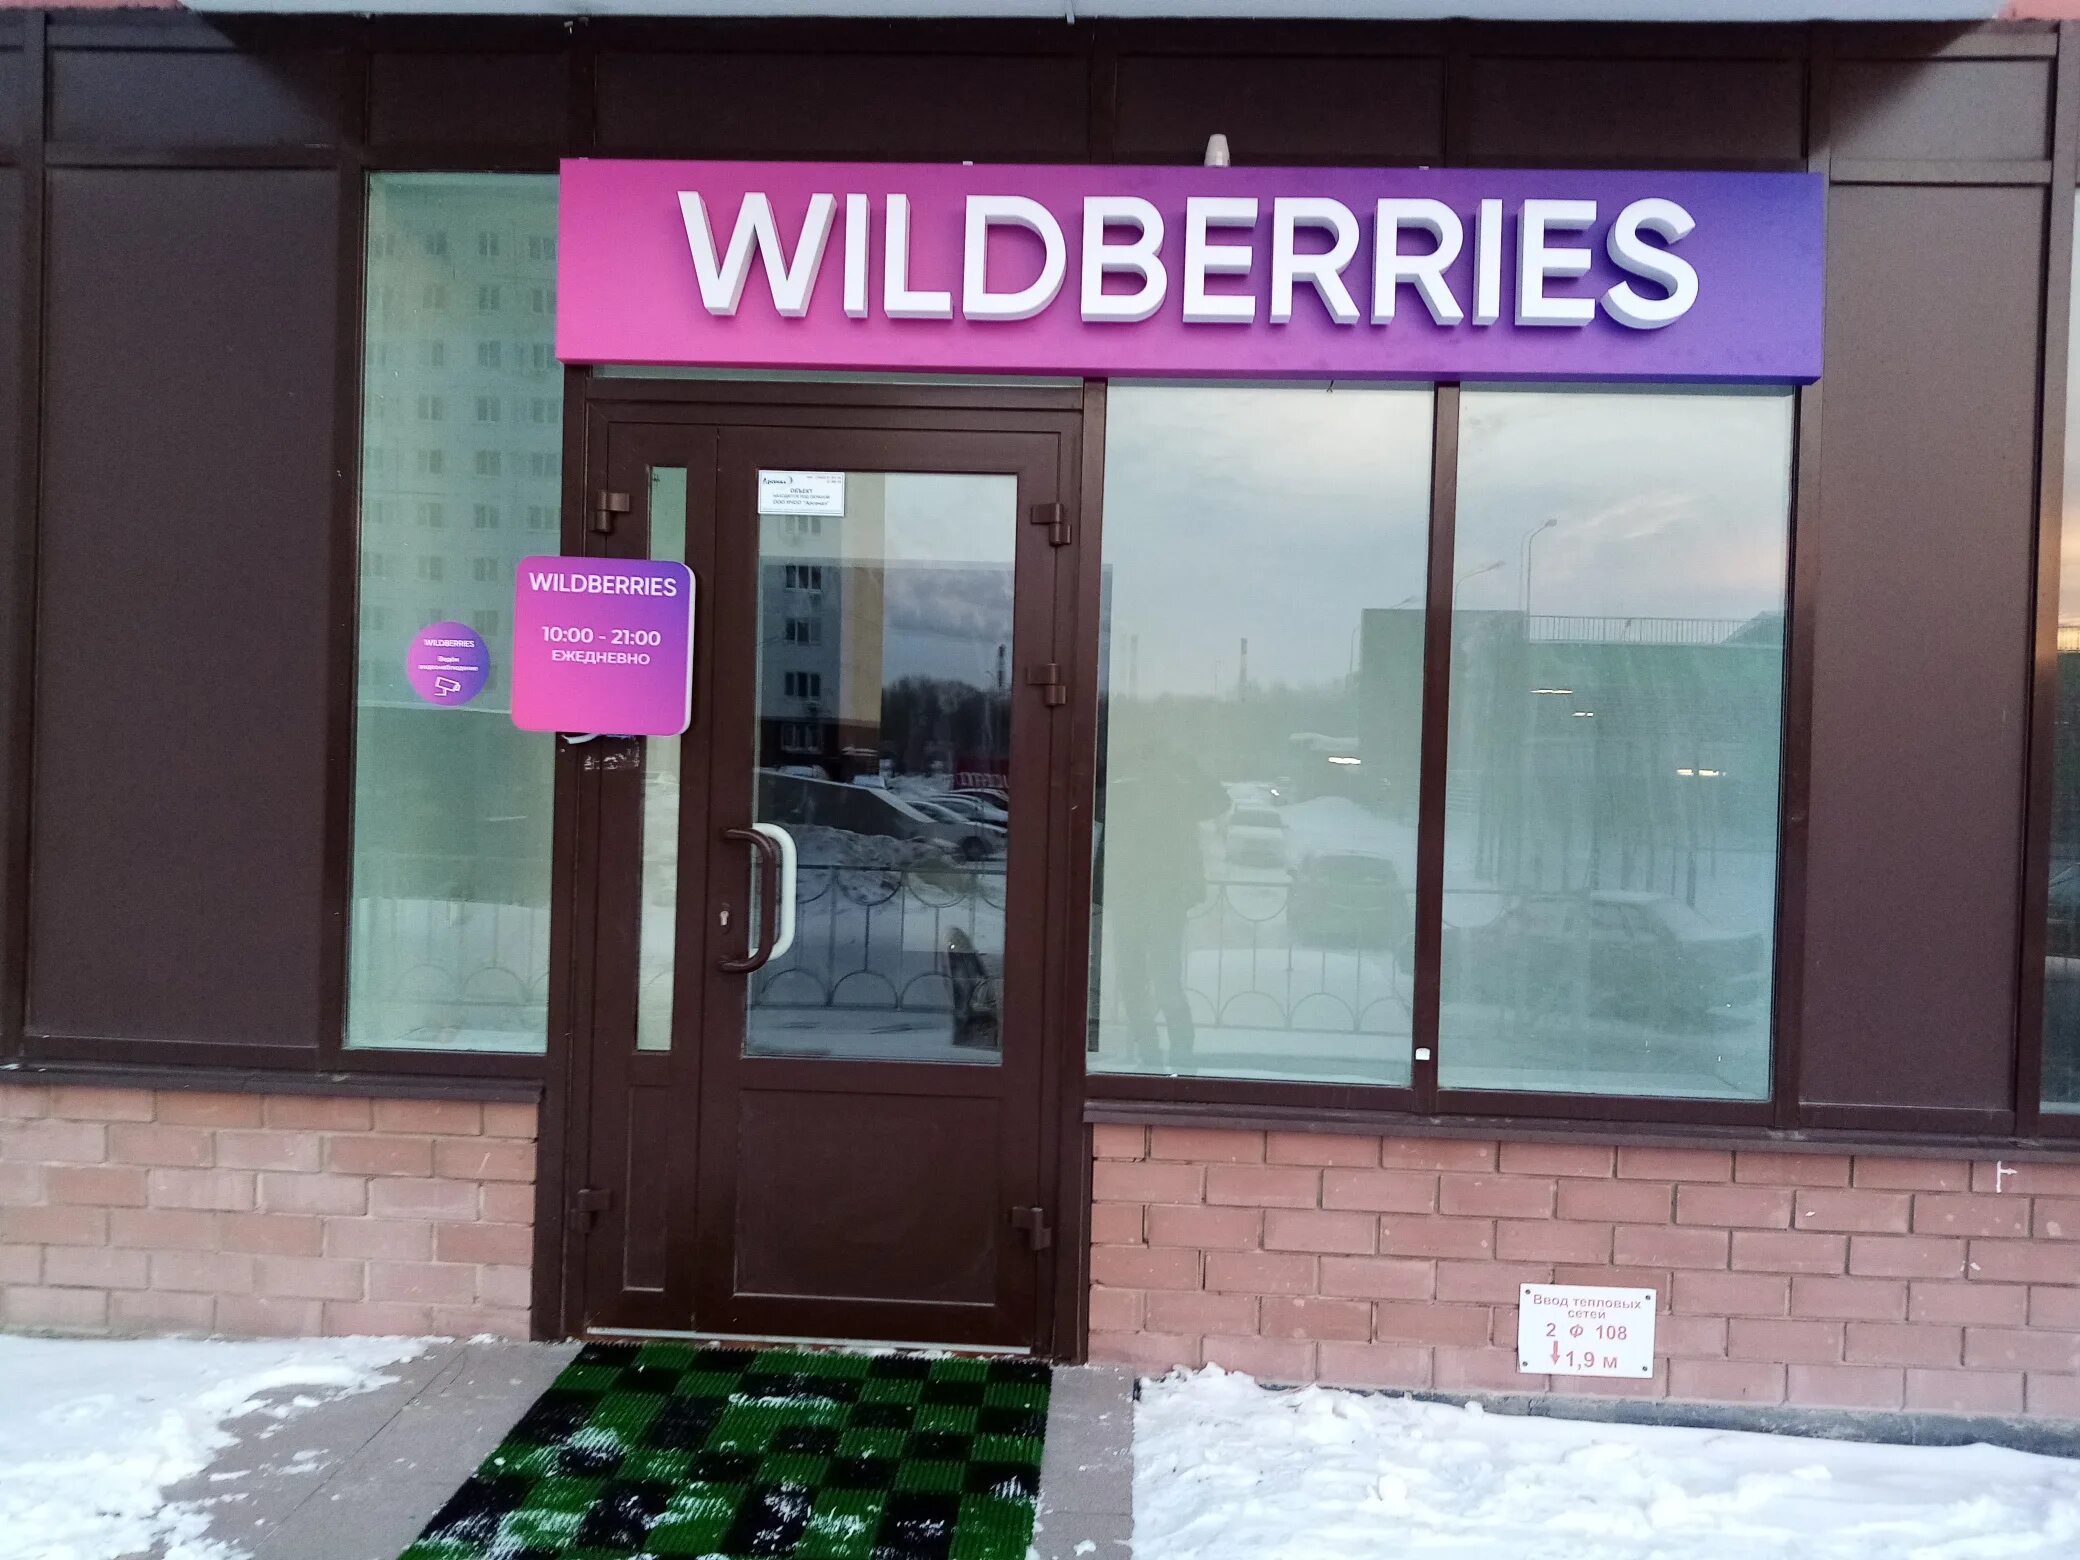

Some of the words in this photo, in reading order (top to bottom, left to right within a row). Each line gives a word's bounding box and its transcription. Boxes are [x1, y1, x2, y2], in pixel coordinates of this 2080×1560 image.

[677, 190, 1699, 330] WILDBERRIES
[529, 571, 678, 598] WILDBERRIES
[423, 638, 475, 648] WILDBERRIES
[541, 626, 594, 644] 10:00
[610, 628, 662, 647] 21:00
[551, 649, 651, 666] ЕЖЕДНЕВНО
[1533, 1293, 1569, 1308] Ввод
[1573, 1296, 1642, 1310] тепловых
[1567, 1308, 1606, 1320] сетей
[1546, 1322, 1557, 1338] 2
[1595, 1325, 1628, 1341] 108
[1566, 1350, 1595, 1371] 1,9
